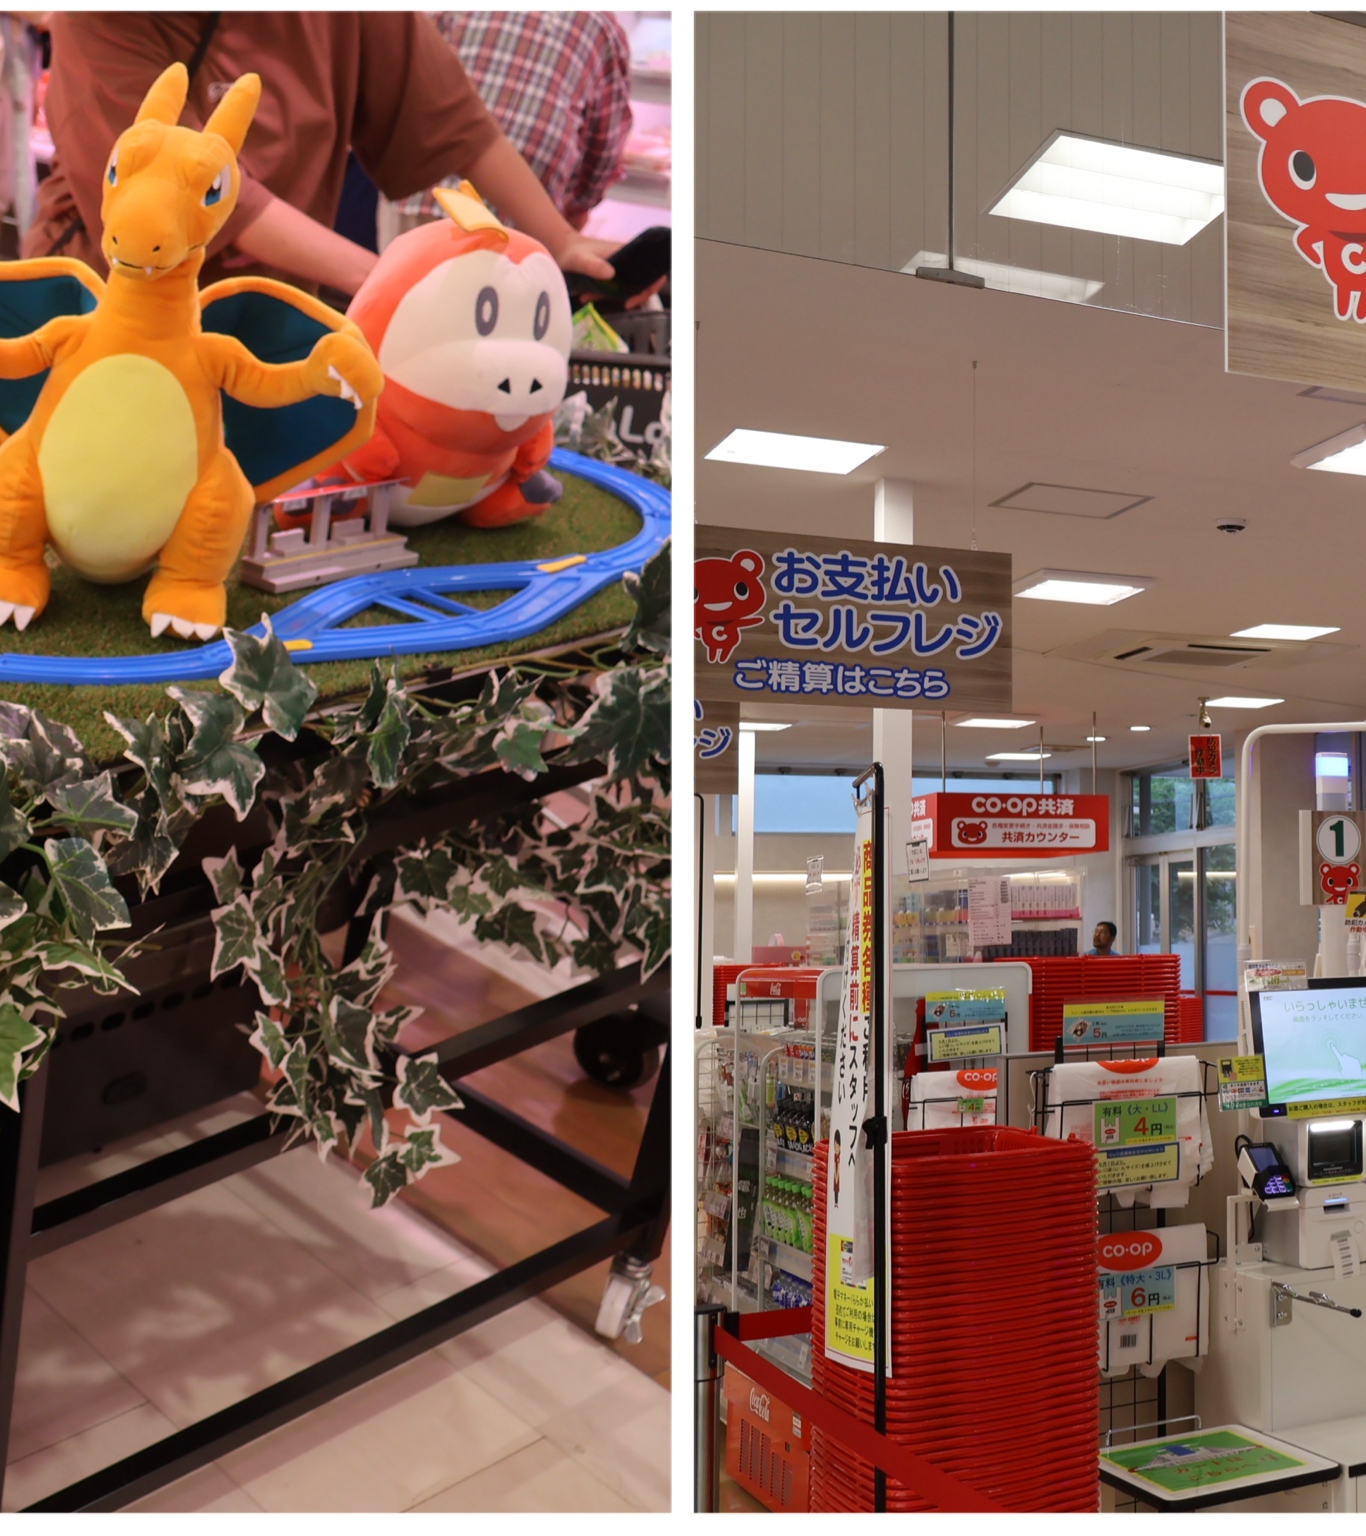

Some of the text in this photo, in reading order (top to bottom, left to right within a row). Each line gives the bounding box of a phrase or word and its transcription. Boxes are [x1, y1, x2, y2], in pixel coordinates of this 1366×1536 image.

[774, 550, 961, 605] お支払い
[772, 605, 1000, 659] セルフレジ
[735, 660, 951, 698] ご精算はこちら
[1001, 831, 1081, 844] 共済カウンター
[1329, 820, 1345, 857] 1
[1292, 1012, 1364, 1024] 画面をタッチしてください
[1132, 1115, 1164, 1136] 4円
[1130, 1286, 1161, 1307] 6円
